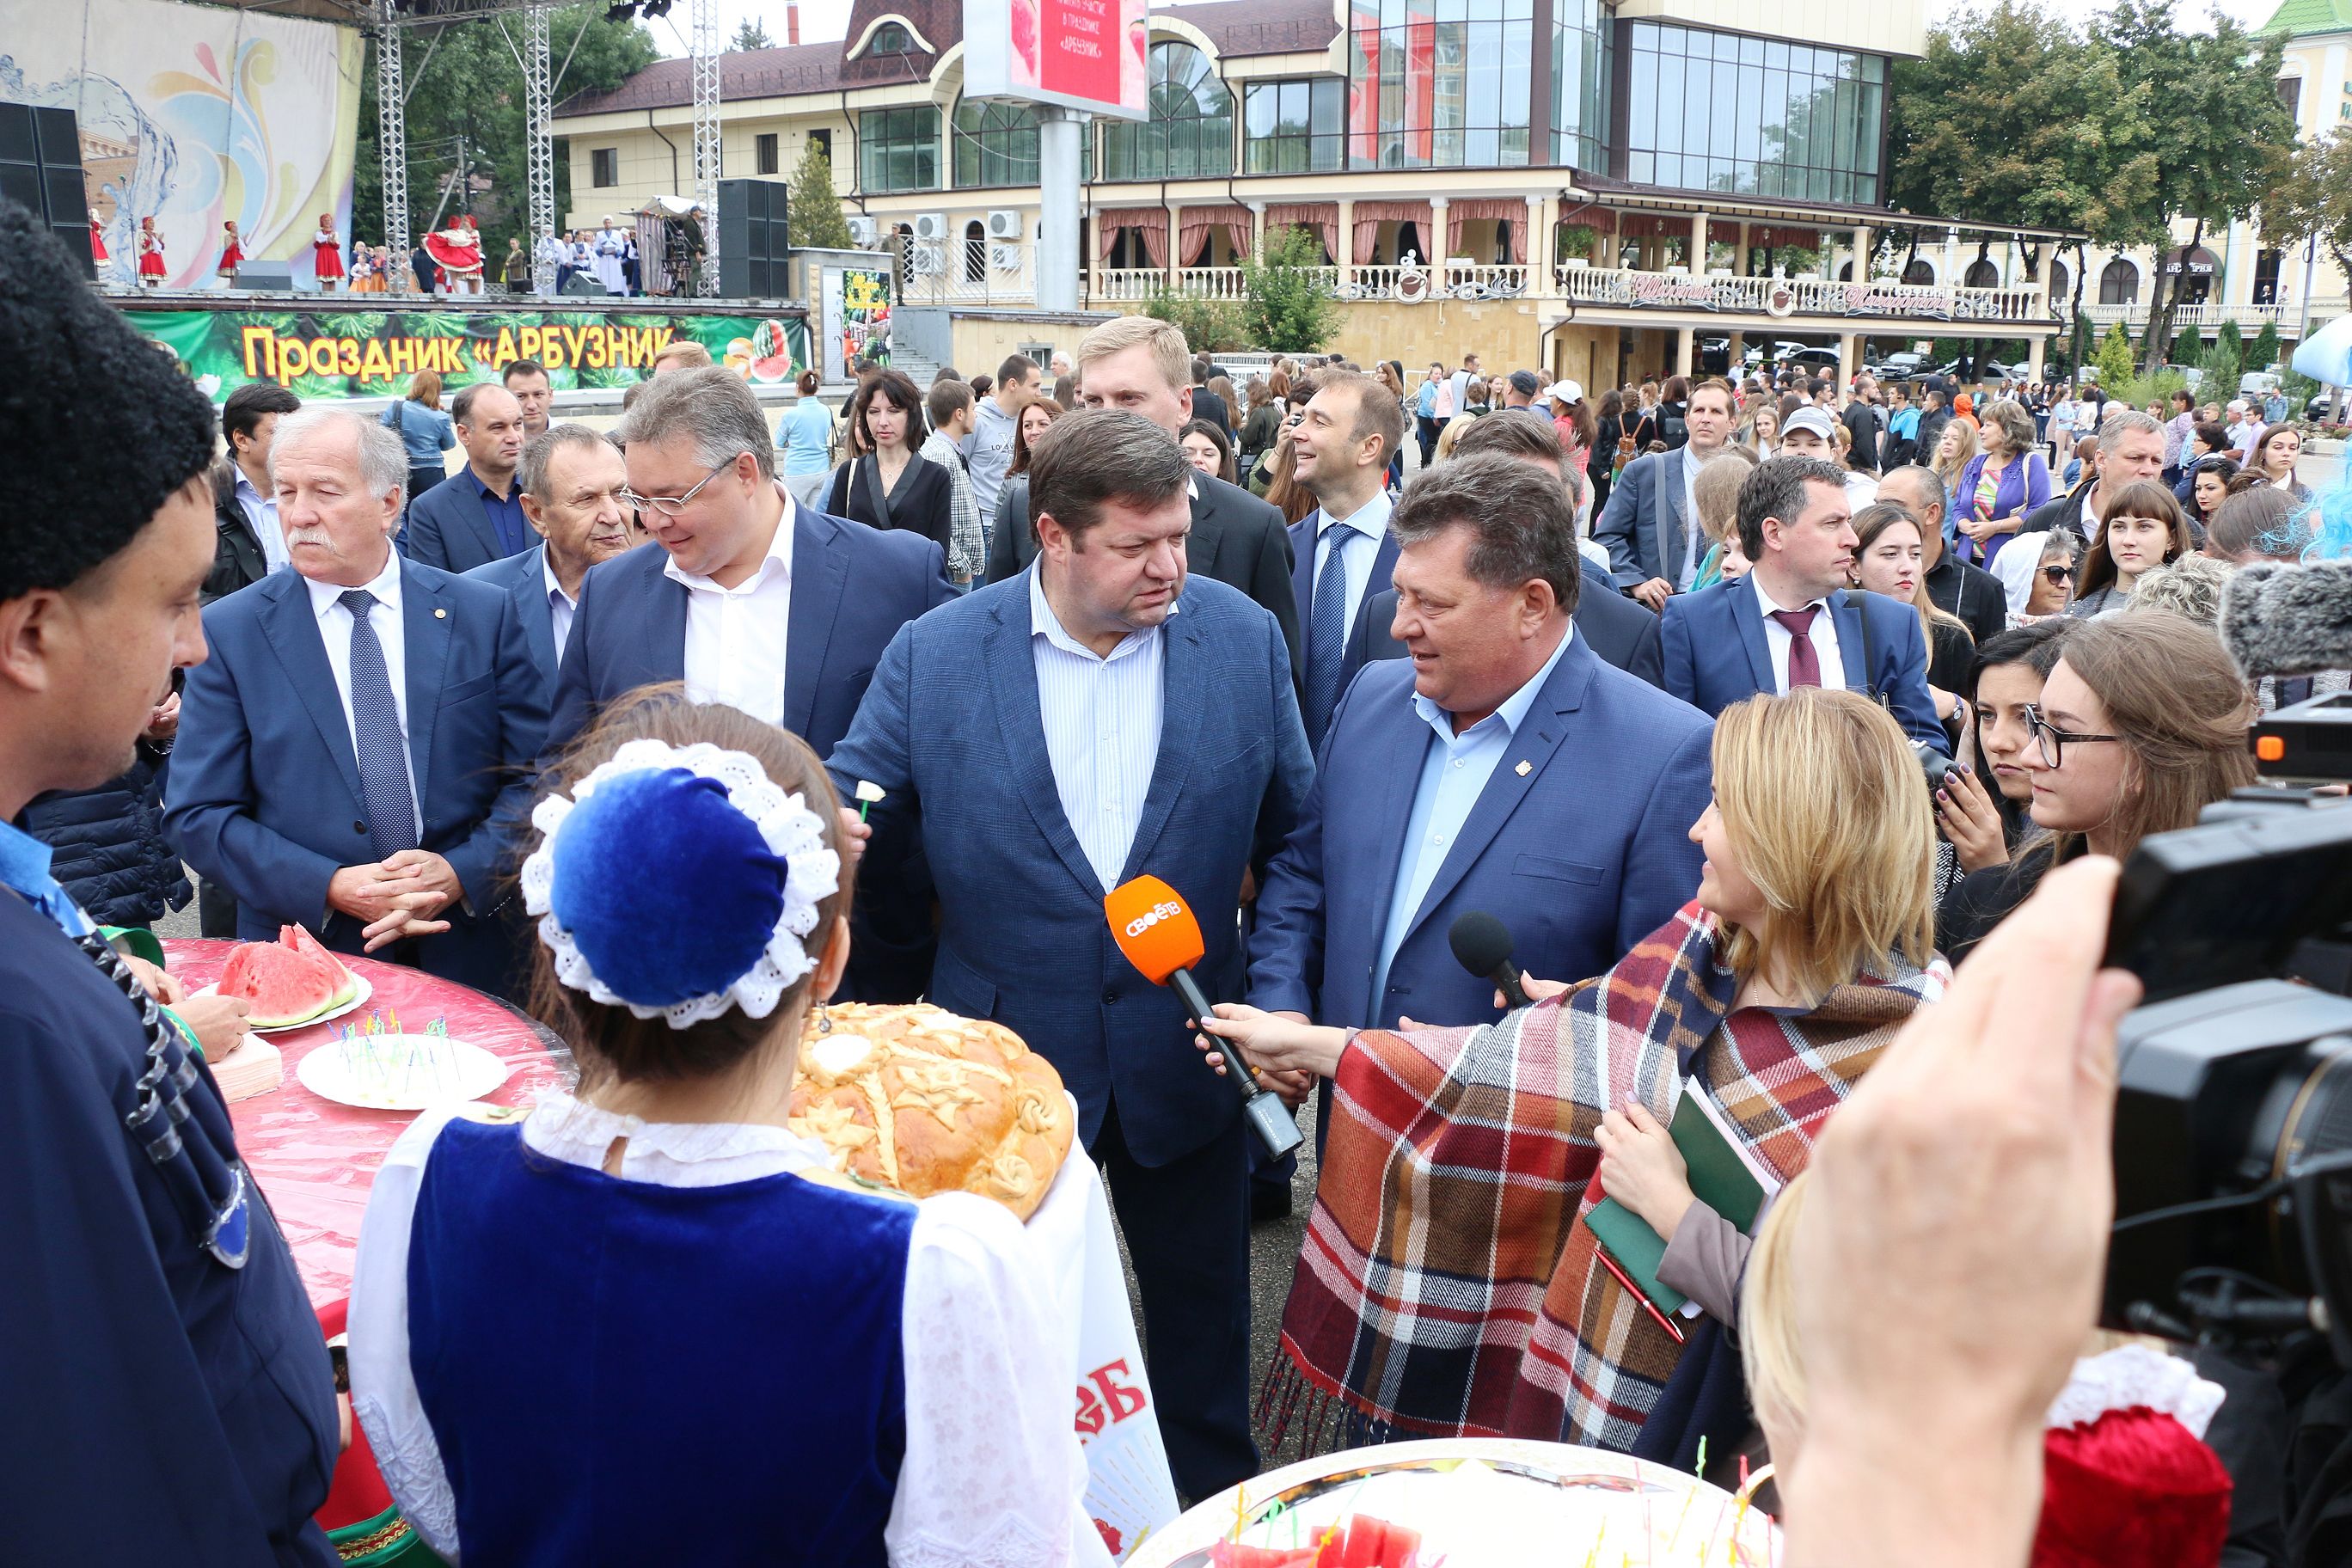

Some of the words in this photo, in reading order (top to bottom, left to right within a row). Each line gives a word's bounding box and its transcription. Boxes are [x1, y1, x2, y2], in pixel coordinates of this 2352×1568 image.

[1063, 11, 1068, 26] В
[1069, 13, 1100, 34] ПРАЗДНИКЕ
[242, 326, 466, 387] Праздник
